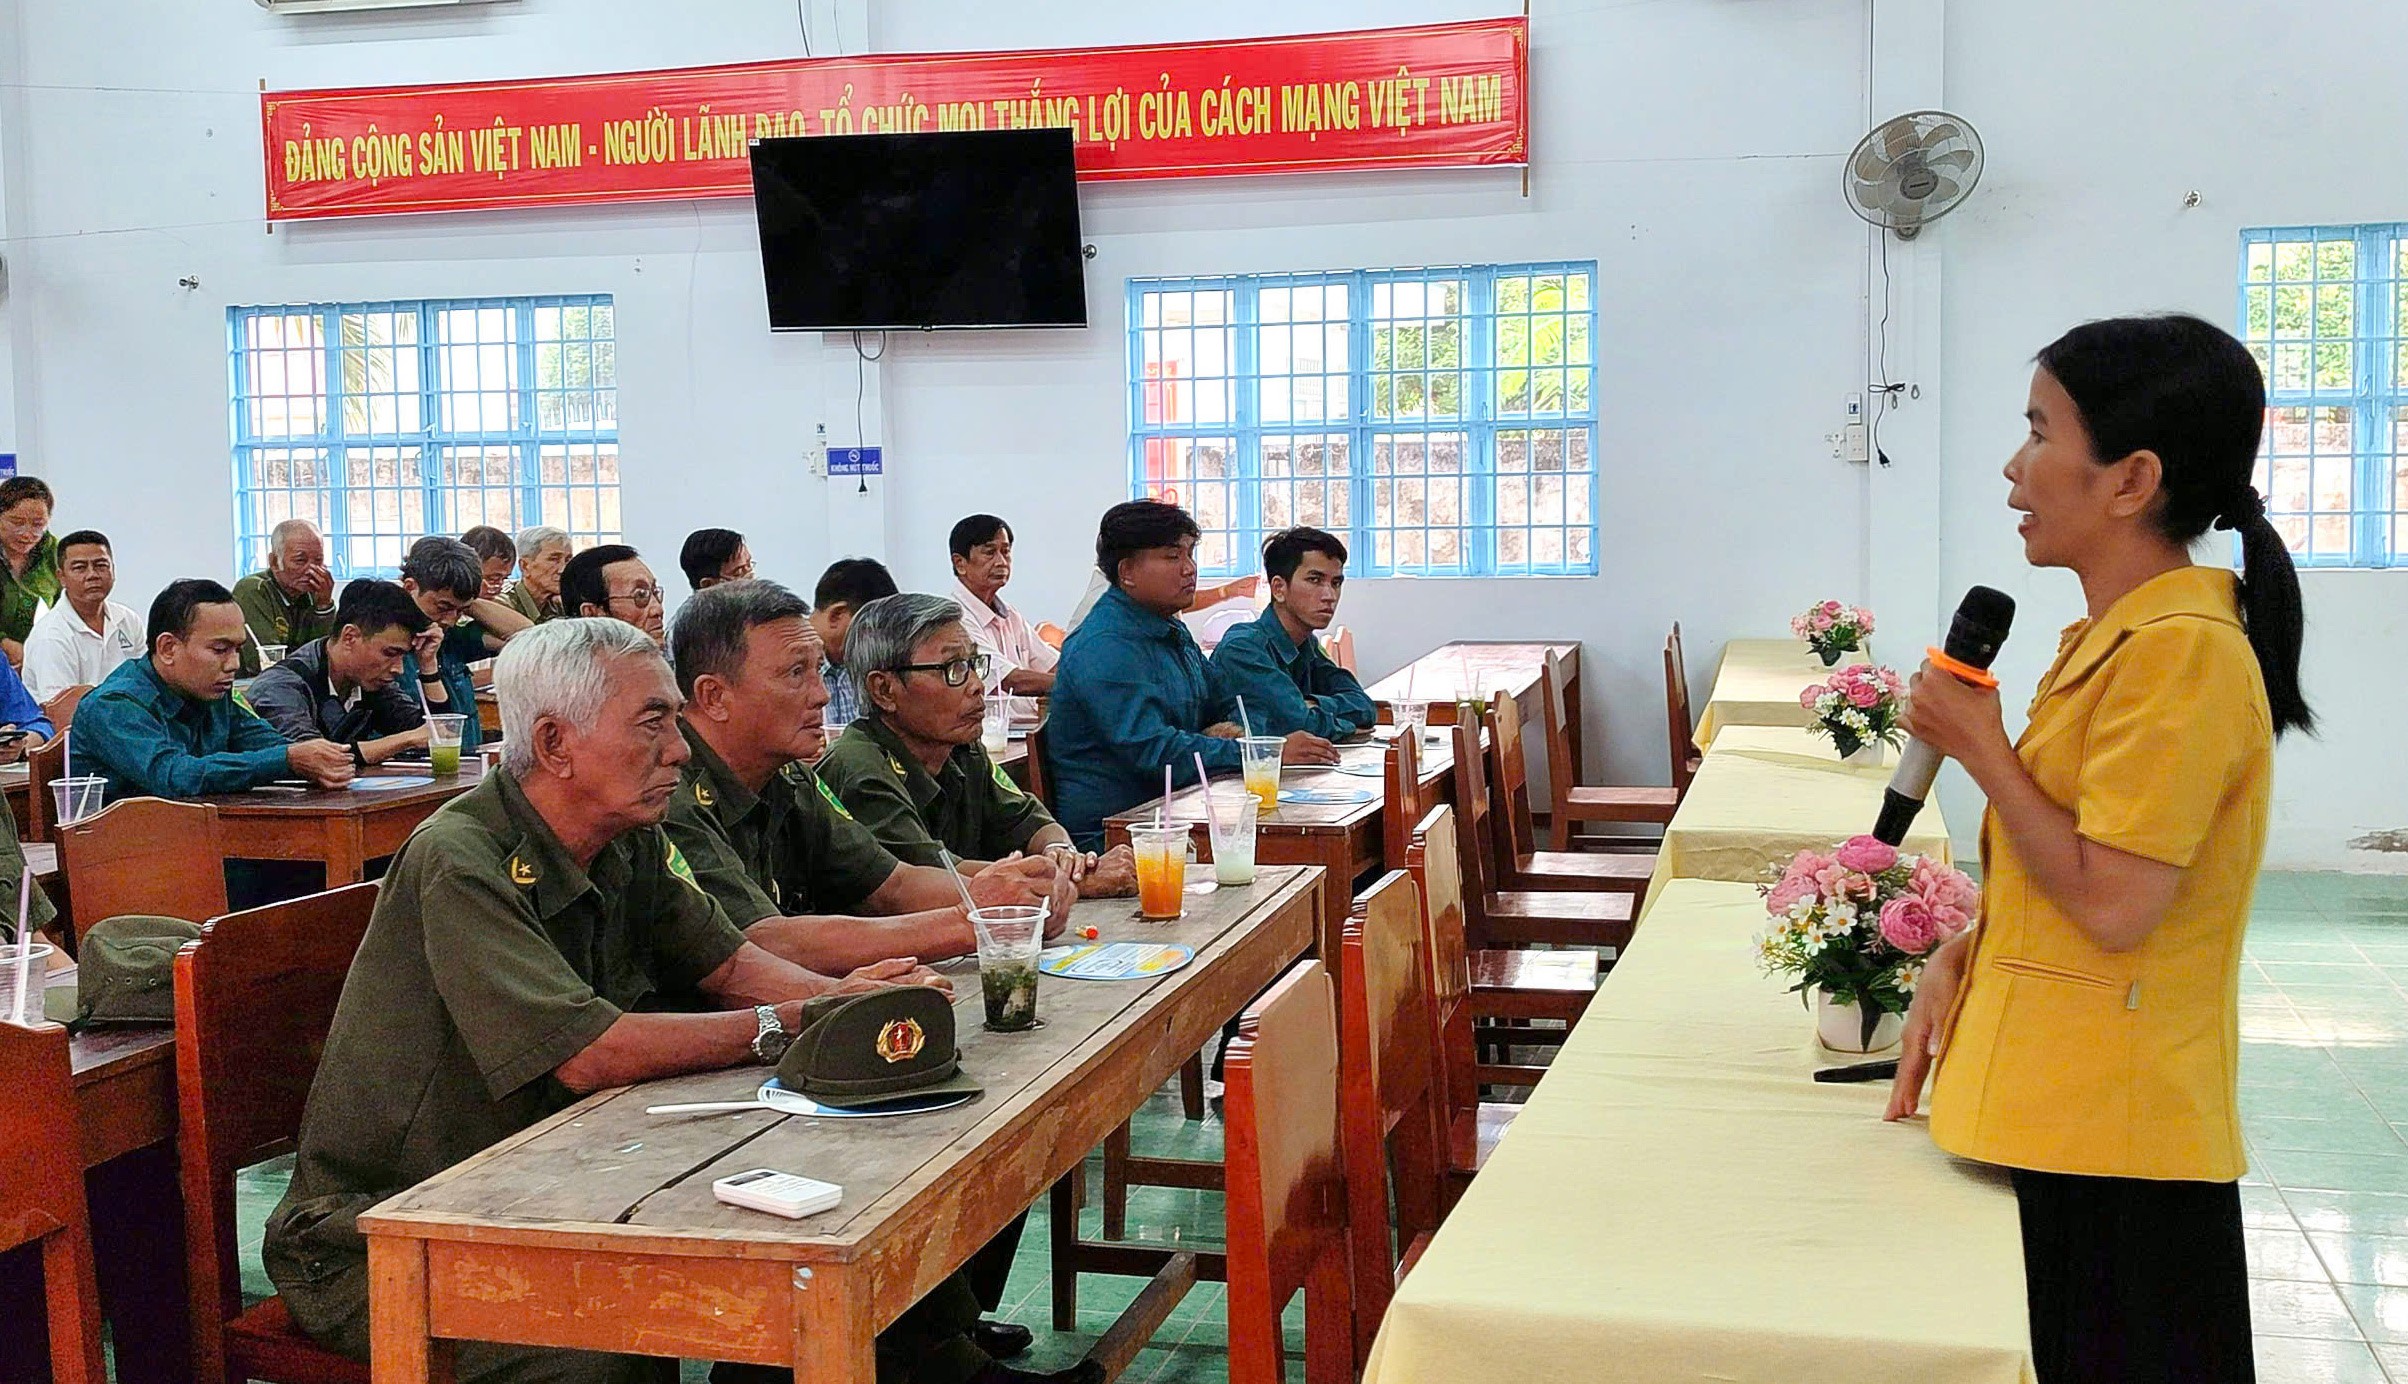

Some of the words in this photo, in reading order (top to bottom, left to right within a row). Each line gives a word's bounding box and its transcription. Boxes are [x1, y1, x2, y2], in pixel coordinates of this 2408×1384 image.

[284, 122, 347, 183] ĐẢNG
[351, 123, 413, 187] CỘNG
[418, 113, 464, 176] SẢN
[469, 116, 522, 181] VIỆT
[530, 123, 582, 169] NAM
[604, 106, 676, 165] NGƯỜI
[683, 104, 747, 161] LÃNH
[819, 83, 855, 137] TỔ
[1088, 87, 1130, 152] LỢI
[1138, 73, 1192, 140] CỦA
[1200, 75, 1271, 137] CÁCH
[1281, 81, 1360, 142] MẠNG
[1367, 65, 1430, 136] VIỆT
[1439, 73, 1502, 125] NAM
